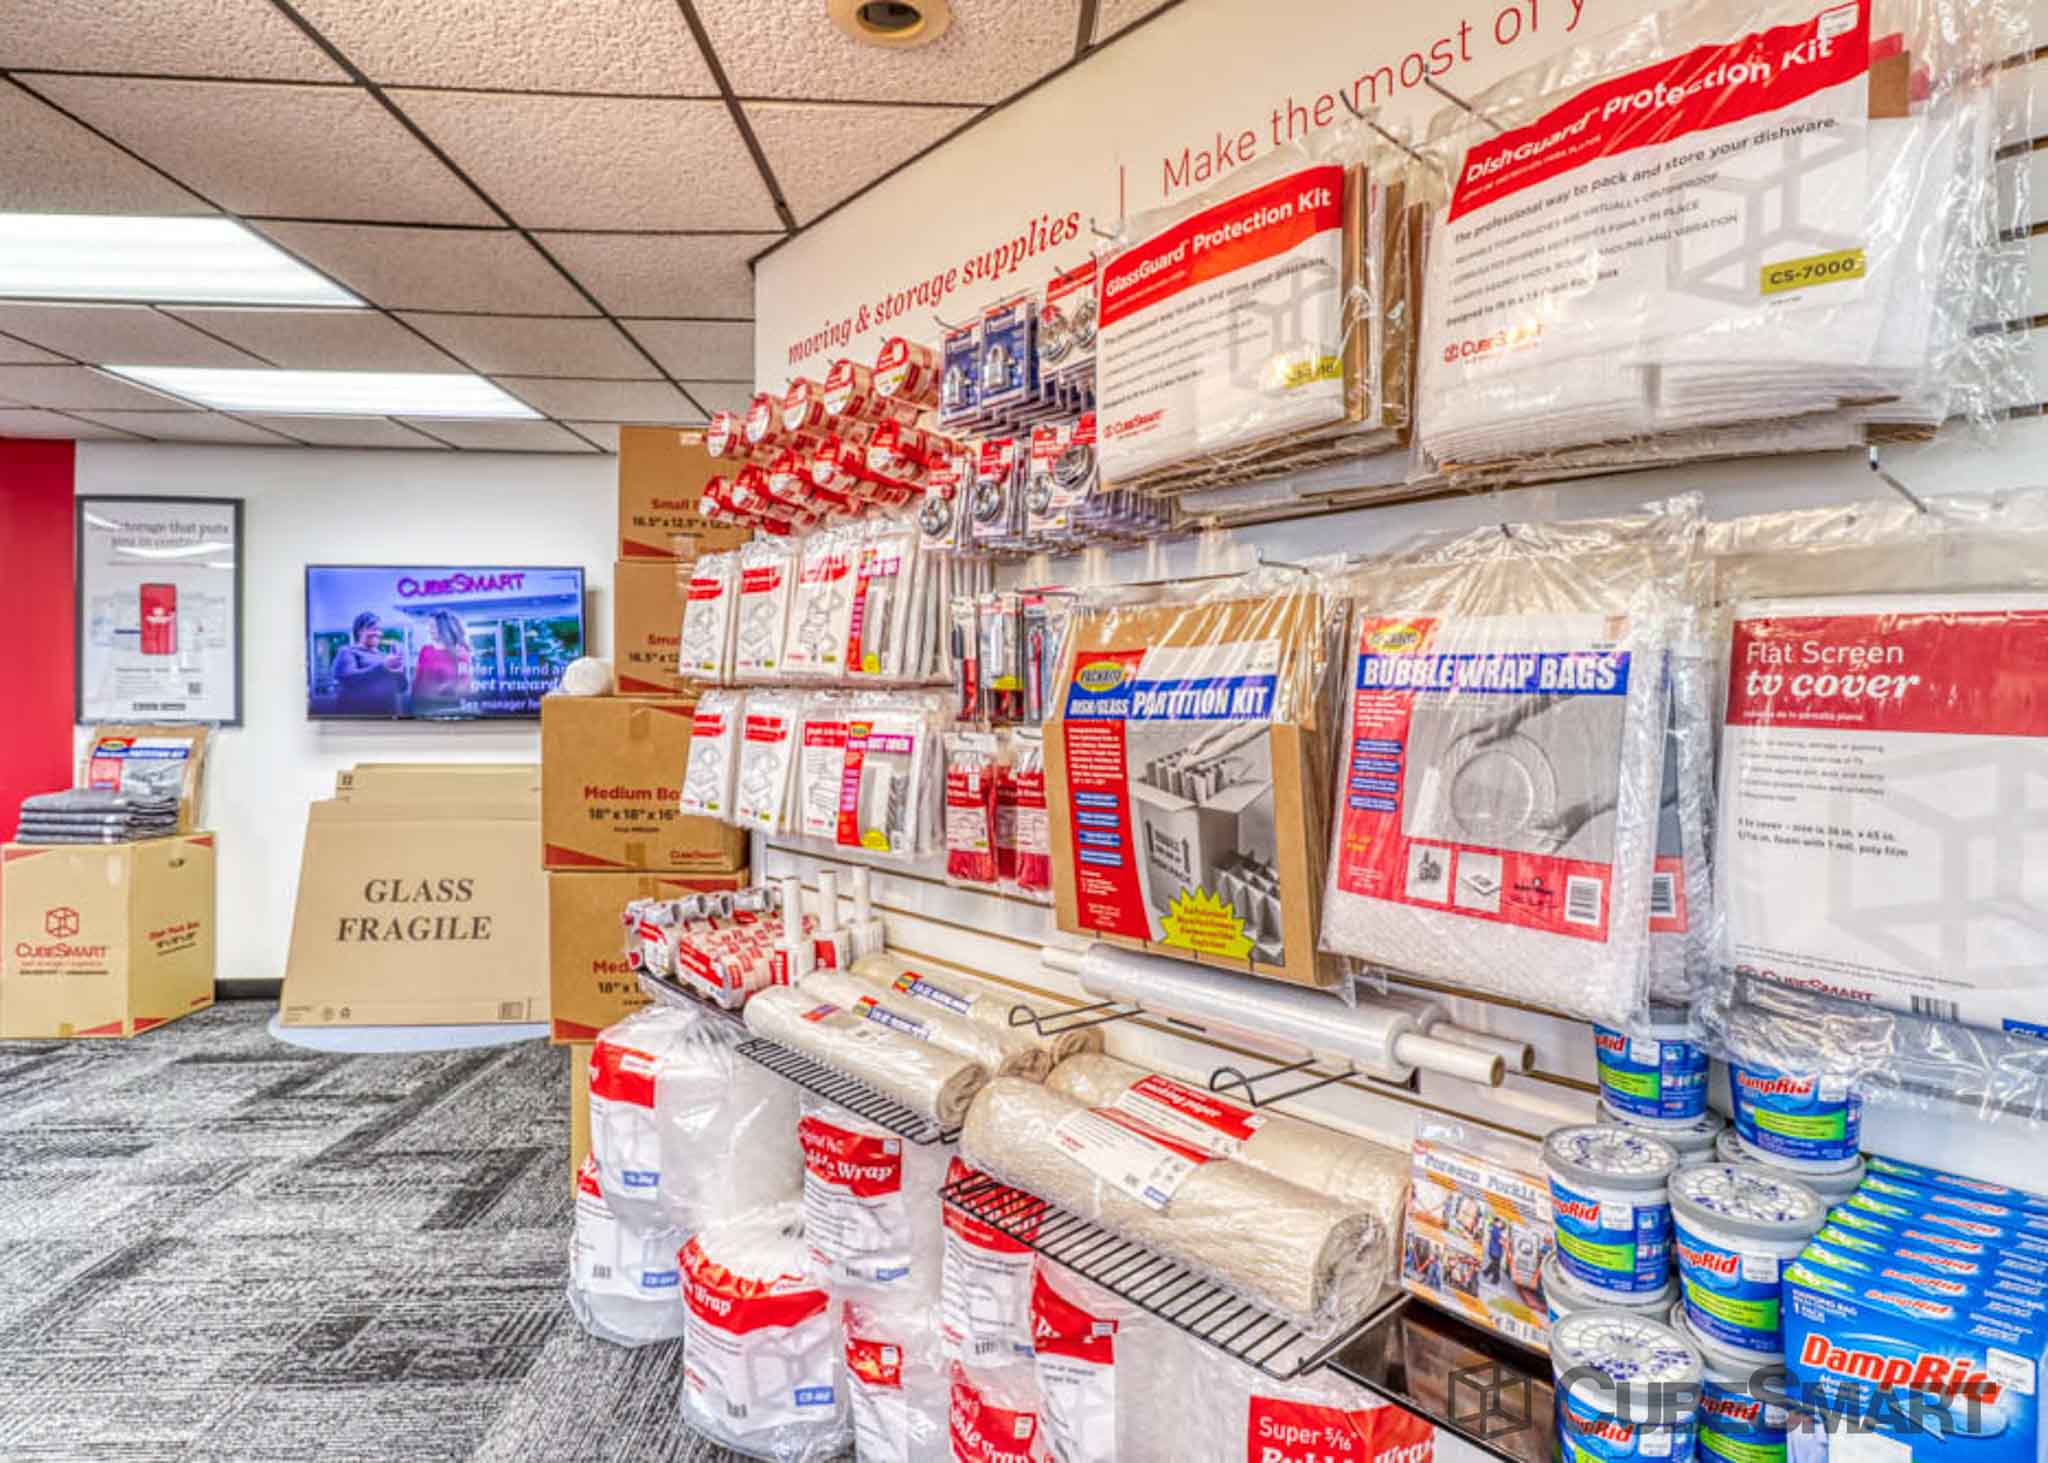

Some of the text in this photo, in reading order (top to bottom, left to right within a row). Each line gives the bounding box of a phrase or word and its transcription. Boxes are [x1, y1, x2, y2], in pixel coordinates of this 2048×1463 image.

[1781, 34, 1837, 72] Kit
[1162, 129, 1257, 197] Make
[1271, 95, 1335, 146] the
[1353, 19, 1474, 105] most
[1574, 181, 1589, 198] to
[1592, 170, 1628, 194] pack
[1632, 159, 1662, 182] and
[1664, 147, 1706, 173] store
[1710, 136, 1751, 160] your
[1754, 116, 1841, 145] dishware.
[1193, 202, 1293, 255] Protection
[1297, 187, 1333, 213] Kit
[1768, 256, 1858, 287] CS-7000
[788, 211, 1081, 366] moving & storage supplies
[1746, 640, 1905, 665] Flat Screen
[509, 660, 549, 675] friend
[1362, 656, 1618, 691] BUBBLE WRAP BAGS
[471, 677, 560, 693] get reward
[1745, 671, 1921, 699] tv cover
[1131, 686, 1230, 717] PARTITION
[1231, 686, 1269, 715] KIT
[583, 785, 681, 801] Medium Bo
[363, 878, 475, 904] GLASS
[336, 915, 493, 943] FRAGILE
[15, 942, 107, 958] CUBESMART
[837, 1160, 894, 1181] Wrap
[1259, 1416, 1319, 1445] Super
